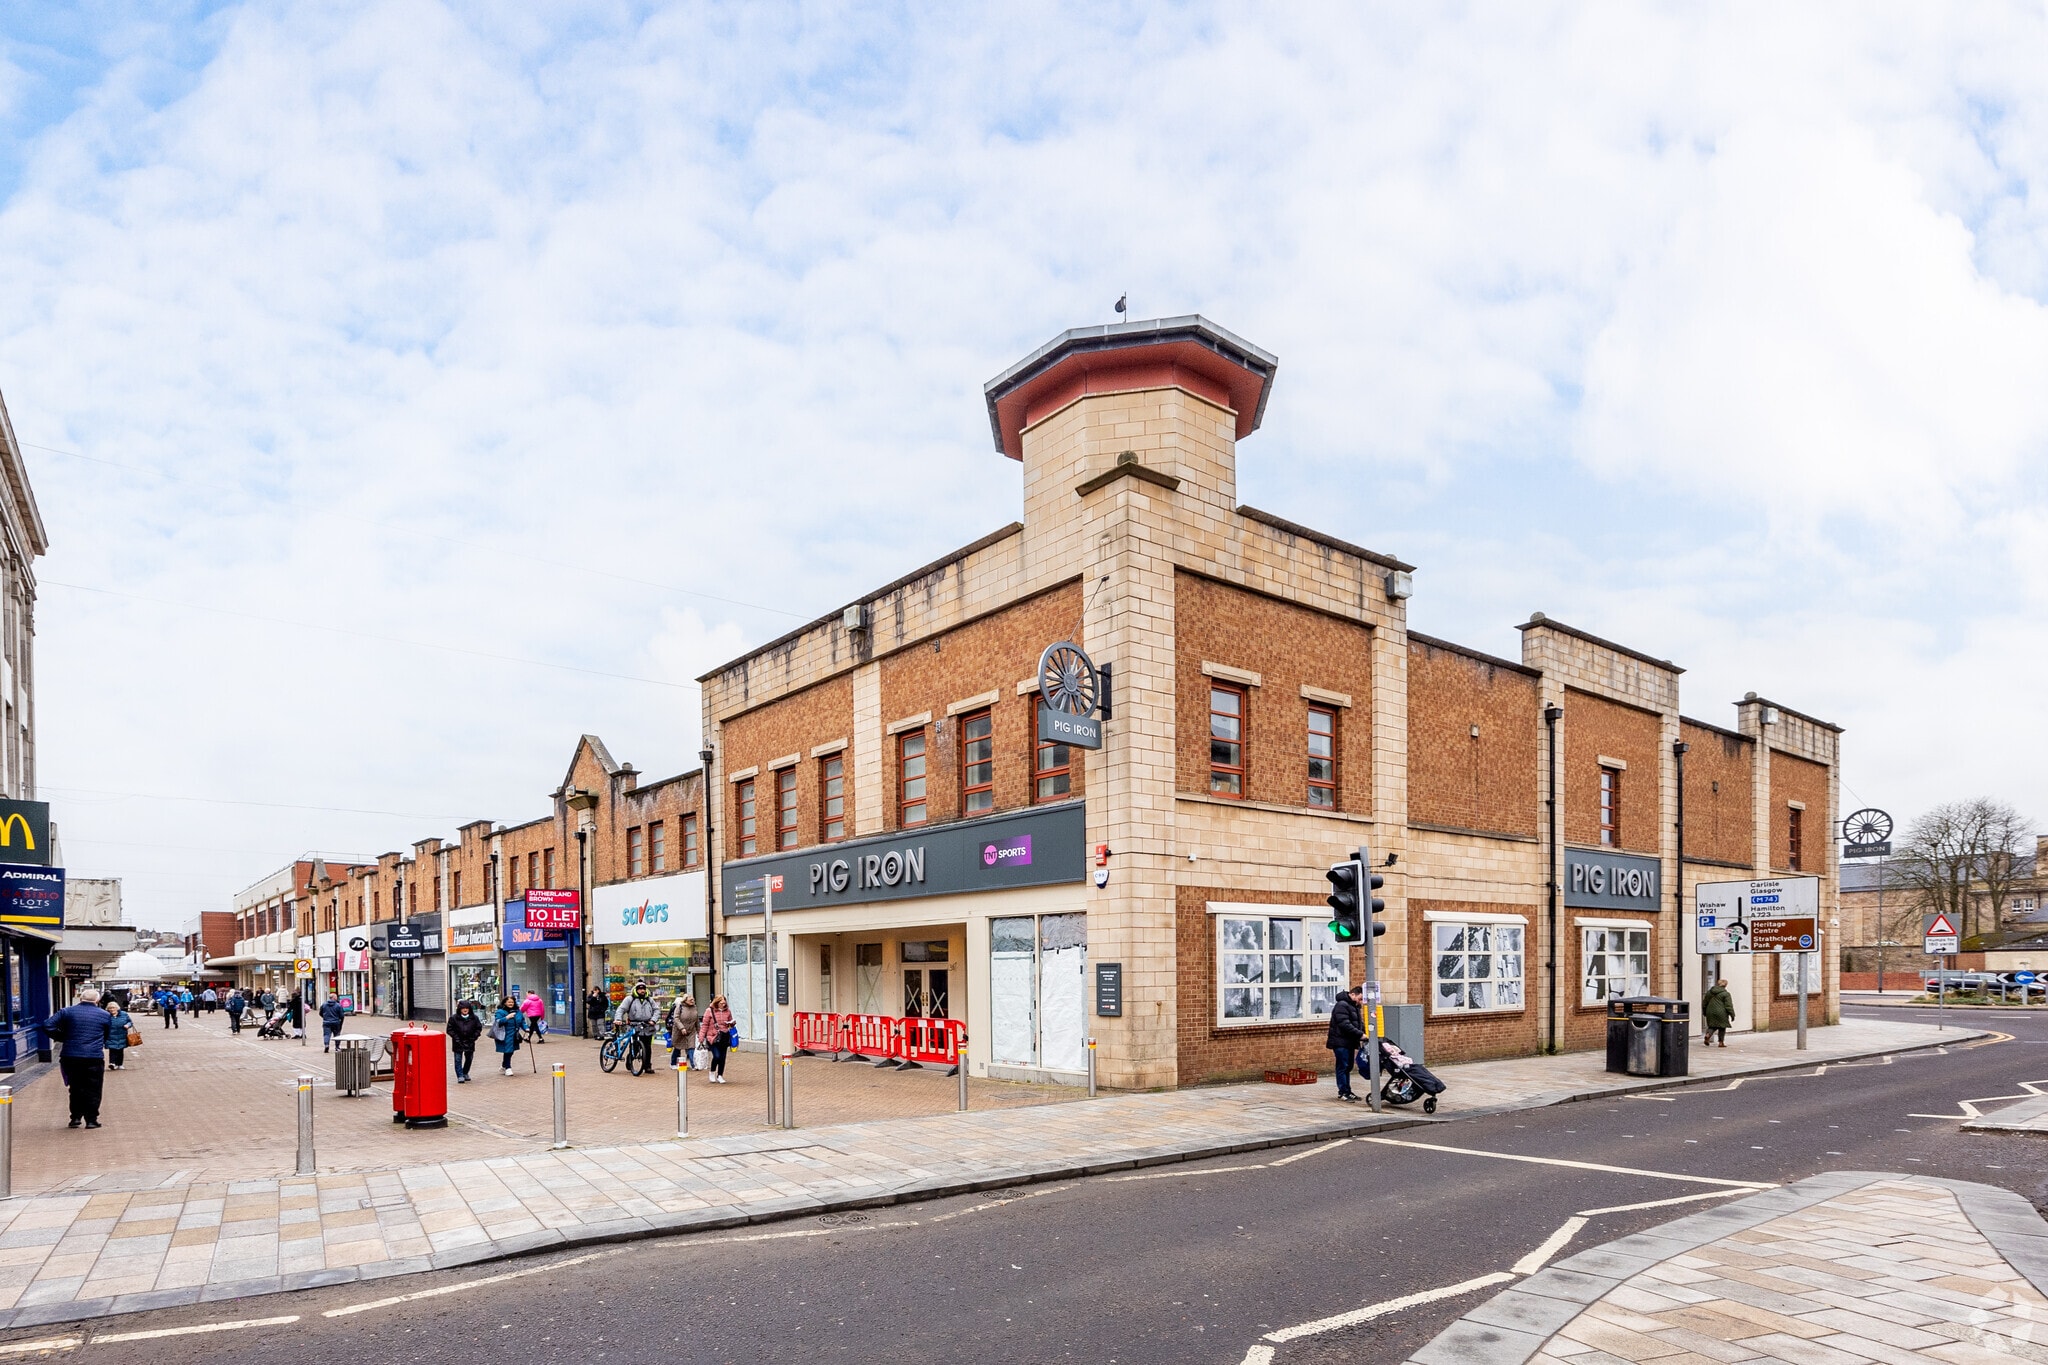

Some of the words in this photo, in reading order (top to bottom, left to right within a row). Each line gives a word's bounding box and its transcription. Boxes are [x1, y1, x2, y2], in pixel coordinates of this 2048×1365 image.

[1054, 720, 1071, 733] PIG
[1073, 723, 1096, 738] IRON
[984, 850, 998, 860] TNT
[998, 846, 1026, 859] SPORTS
[2, 871, 61, 881] ADMIRAL
[809, 859, 849, 894] PIG
[857, 846, 926, 889] IRON
[771, 879, 783, 889] rts
[1572, 862, 1606, 894] PIG
[1611, 867, 1654, 898] IRON
[1750, 887, 1783, 895] Glasgow
[12, 898, 49, 907] SLOTS
[528, 909, 548, 921] TO
[553, 909, 579, 921] LET
[622, 898, 669, 926] savers
[1701, 917, 1710, 926] P
[453, 930, 470, 946] Home
[469, 927, 493, 945] Interiors
[512, 928, 531, 943] Shoe
